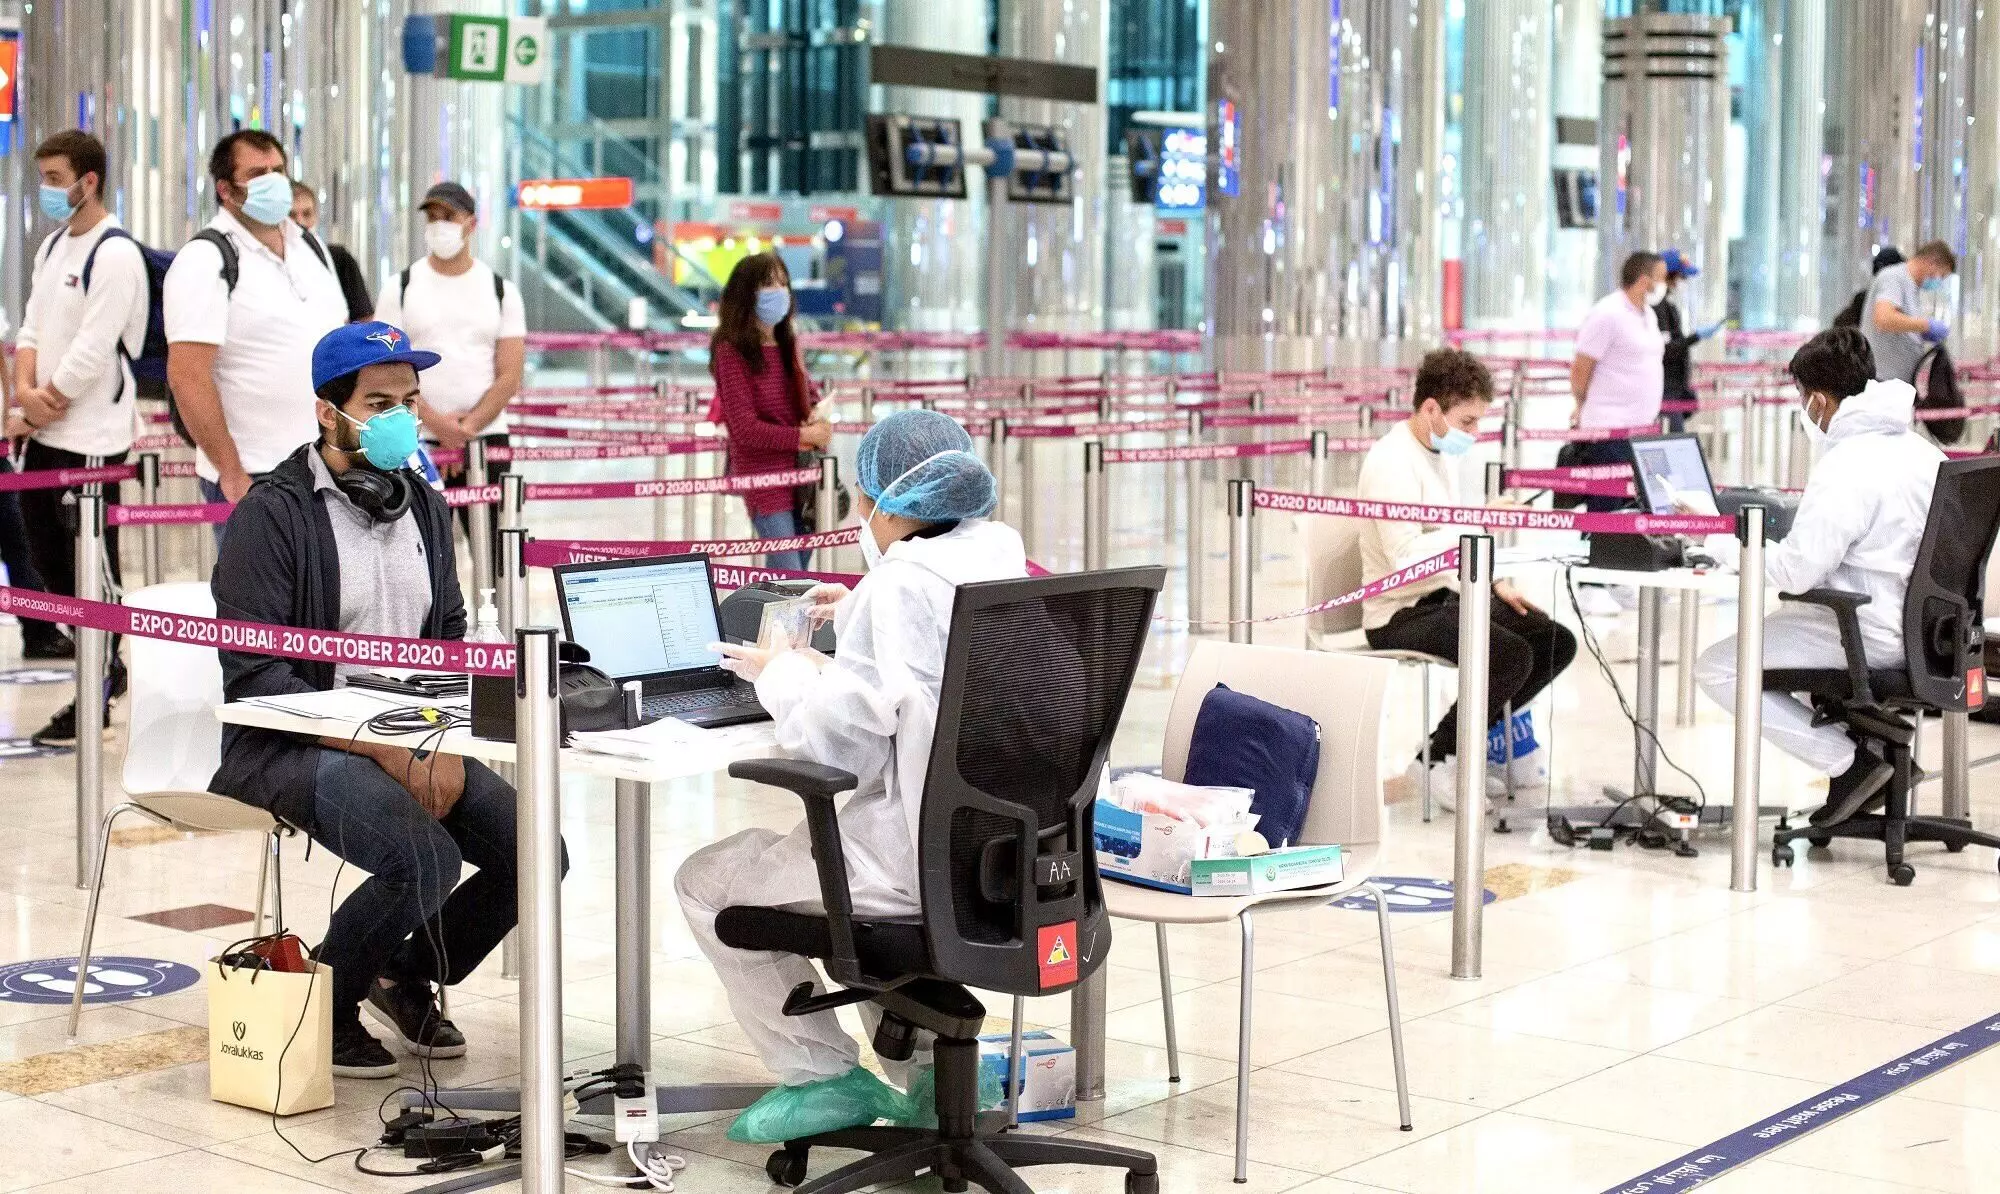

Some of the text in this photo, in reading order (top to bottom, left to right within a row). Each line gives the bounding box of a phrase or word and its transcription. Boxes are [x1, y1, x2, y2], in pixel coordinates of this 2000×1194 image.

[634, 483, 664, 496] EXPO
[665, 481, 693, 494] 2020
[1270, 493, 1305, 510] 2020
[1357, 501, 1384, 517] THE
[1386, 504, 1451, 522] WORLD'S
[1453, 511, 1525, 526] GREATEST
[1528, 514, 1575, 528] SHOW
[727, 540, 761, 555] 2020
[806, 535, 824, 548] 20
[1382, 576, 1401, 592] 10
[1403, 555, 1450, 584] APRIL
[130, 612, 174, 636] EXPO
[176, 619, 219, 642] 2020
[221, 625, 277, 650] DUBAI:
[282, 631, 305, 652] 20
[308, 634, 393, 663] OCTOBER
[397, 642, 445, 666] 2020
[464, 647, 488, 669] 10
[1049, 861, 1071, 882] AA
[221, 1040, 263, 1061] Joyalukkas
[1753, 1093, 1861, 1139] Please wait here
